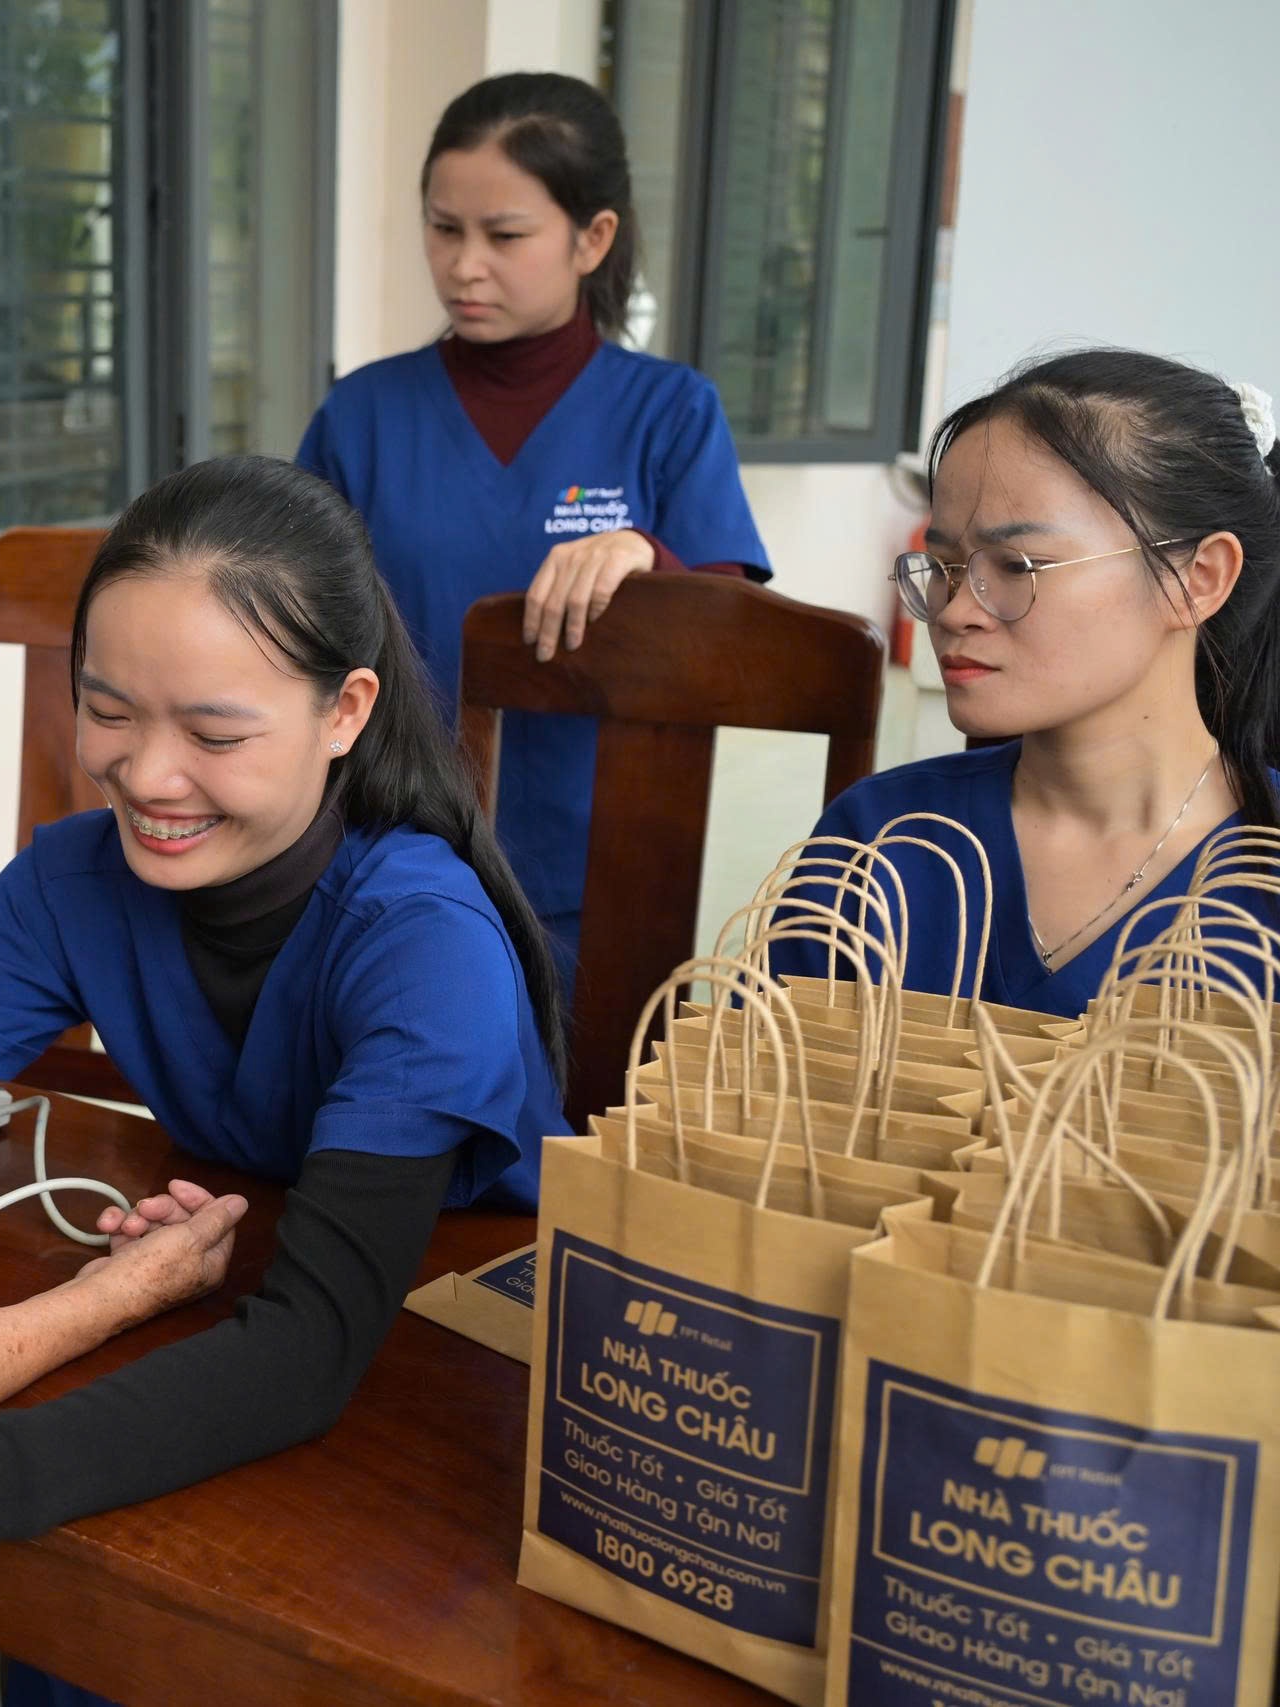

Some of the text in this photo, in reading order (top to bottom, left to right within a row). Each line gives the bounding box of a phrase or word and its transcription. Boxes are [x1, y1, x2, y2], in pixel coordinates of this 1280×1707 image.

[581, 1362, 776, 1461] LONG CHÂU
[602, 1335, 751, 1410] NHÀ THUỐC
[563, 1417, 788, 1524] Thuốc Tốt Giá Tốt
[564, 1449, 612, 1486] Giao
[616, 1473, 678, 1521] Hàng
[684, 1501, 731, 1537] Tận
[909, 1511, 1182, 1609] LONG CHÂU
[942, 1479, 1150, 1553] NHÀ THUỐC
[595, 1528, 734, 1612] 1800 6928
[883, 1575, 1195, 1681] Thuốc Tốt Giá Tốt
[884, 1611, 957, 1652] Giao
[963, 1638, 1049, 1688] Hàng
[1057, 1663, 1121, 1700] Tận
